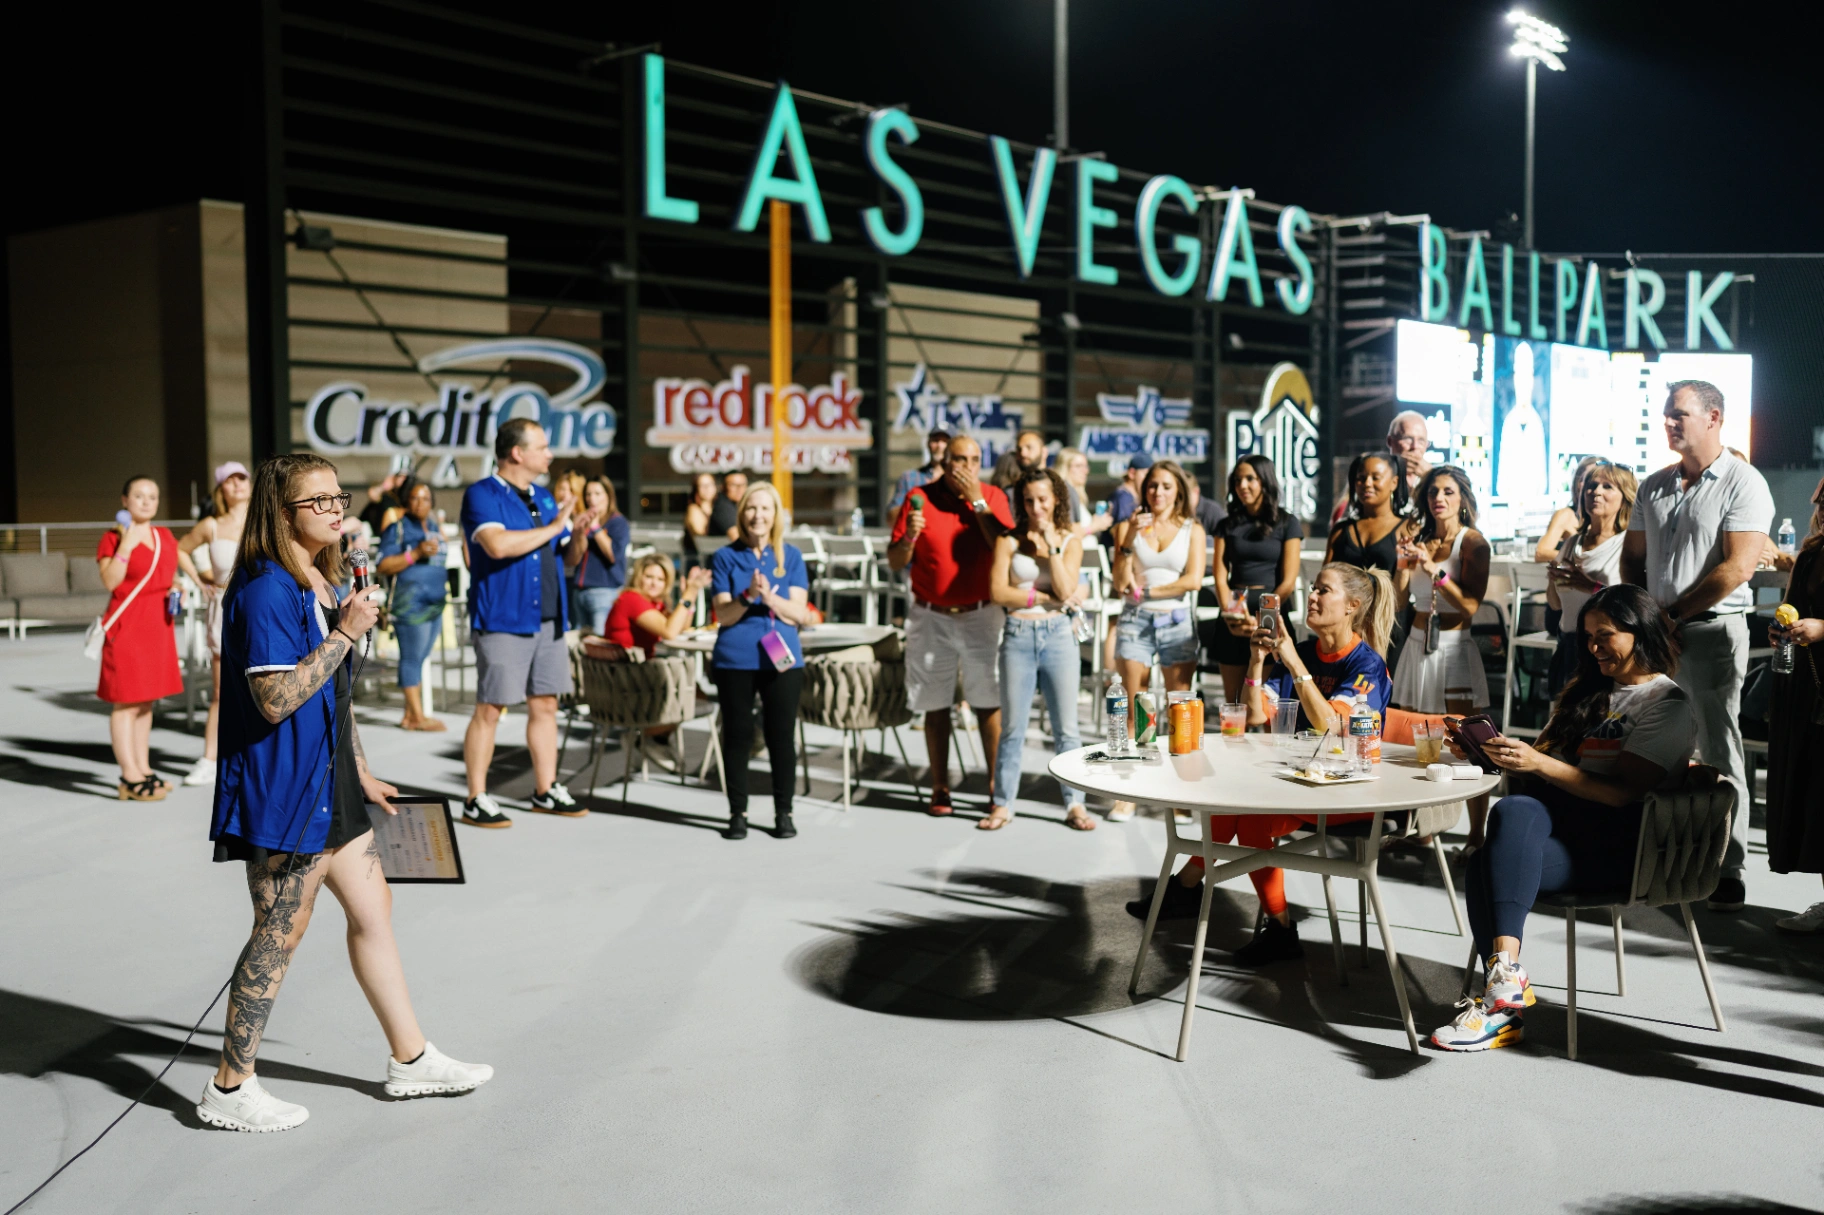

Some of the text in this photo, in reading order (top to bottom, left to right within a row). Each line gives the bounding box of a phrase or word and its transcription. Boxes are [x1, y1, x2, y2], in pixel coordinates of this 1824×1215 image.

[643, 52, 1735, 350] LAS VEGAS BALLPARK
[654, 367, 750, 429] red
